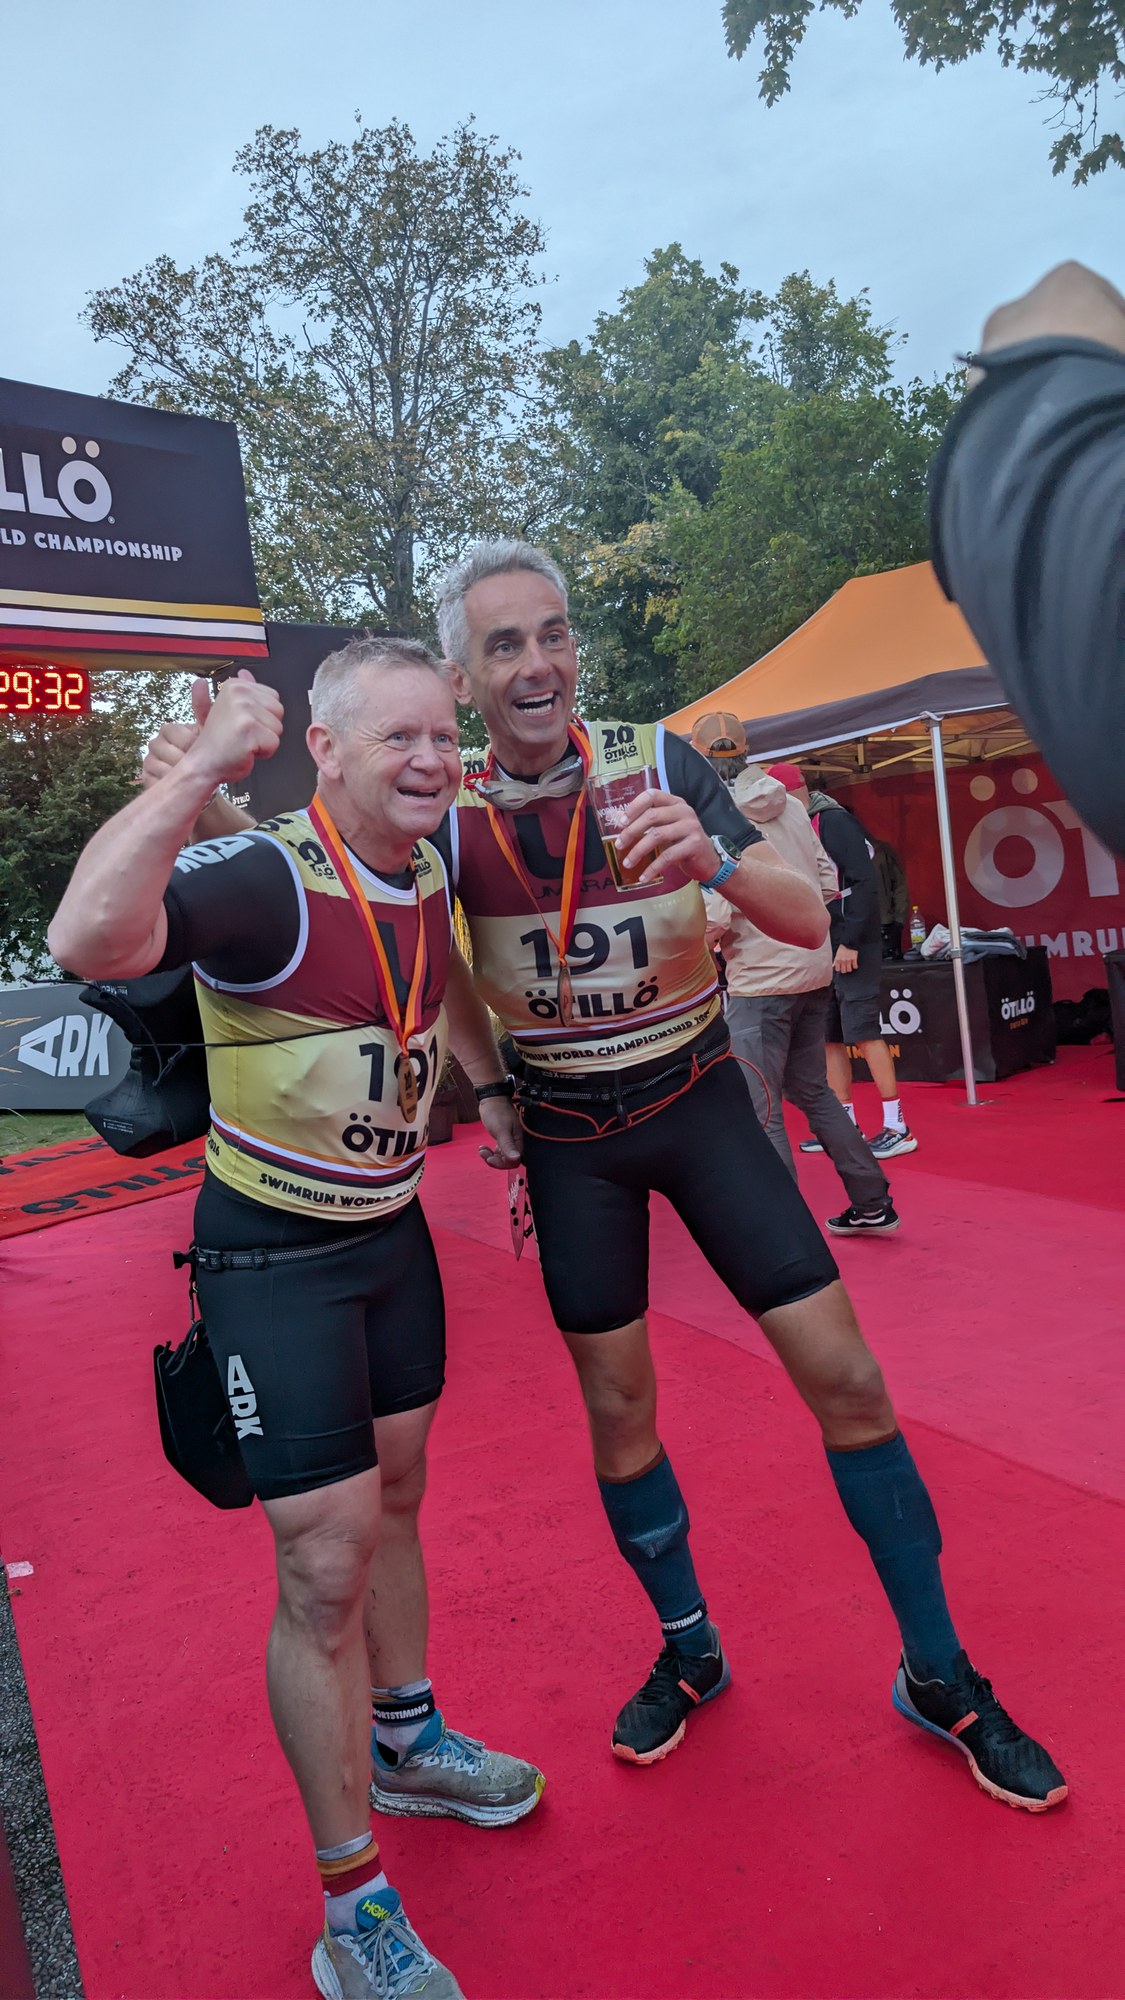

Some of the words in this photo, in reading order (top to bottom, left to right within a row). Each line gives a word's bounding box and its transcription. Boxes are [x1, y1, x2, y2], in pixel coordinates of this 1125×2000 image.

[34, 531, 183, 562] CHAMPIONSHIP
[602, 725, 634, 750] 20
[520, 915, 649, 979] 191
[18, 1013, 113, 1077] ARK
[551, 1049, 594, 1062] WORLD
[597, 1021, 693, 1058] CHAMPIONSHIP
[359, 1034, 438, 1107] 191
[259, 1173, 336, 1205] SWIMRUN
[228, 1355, 264, 1440] ARK
